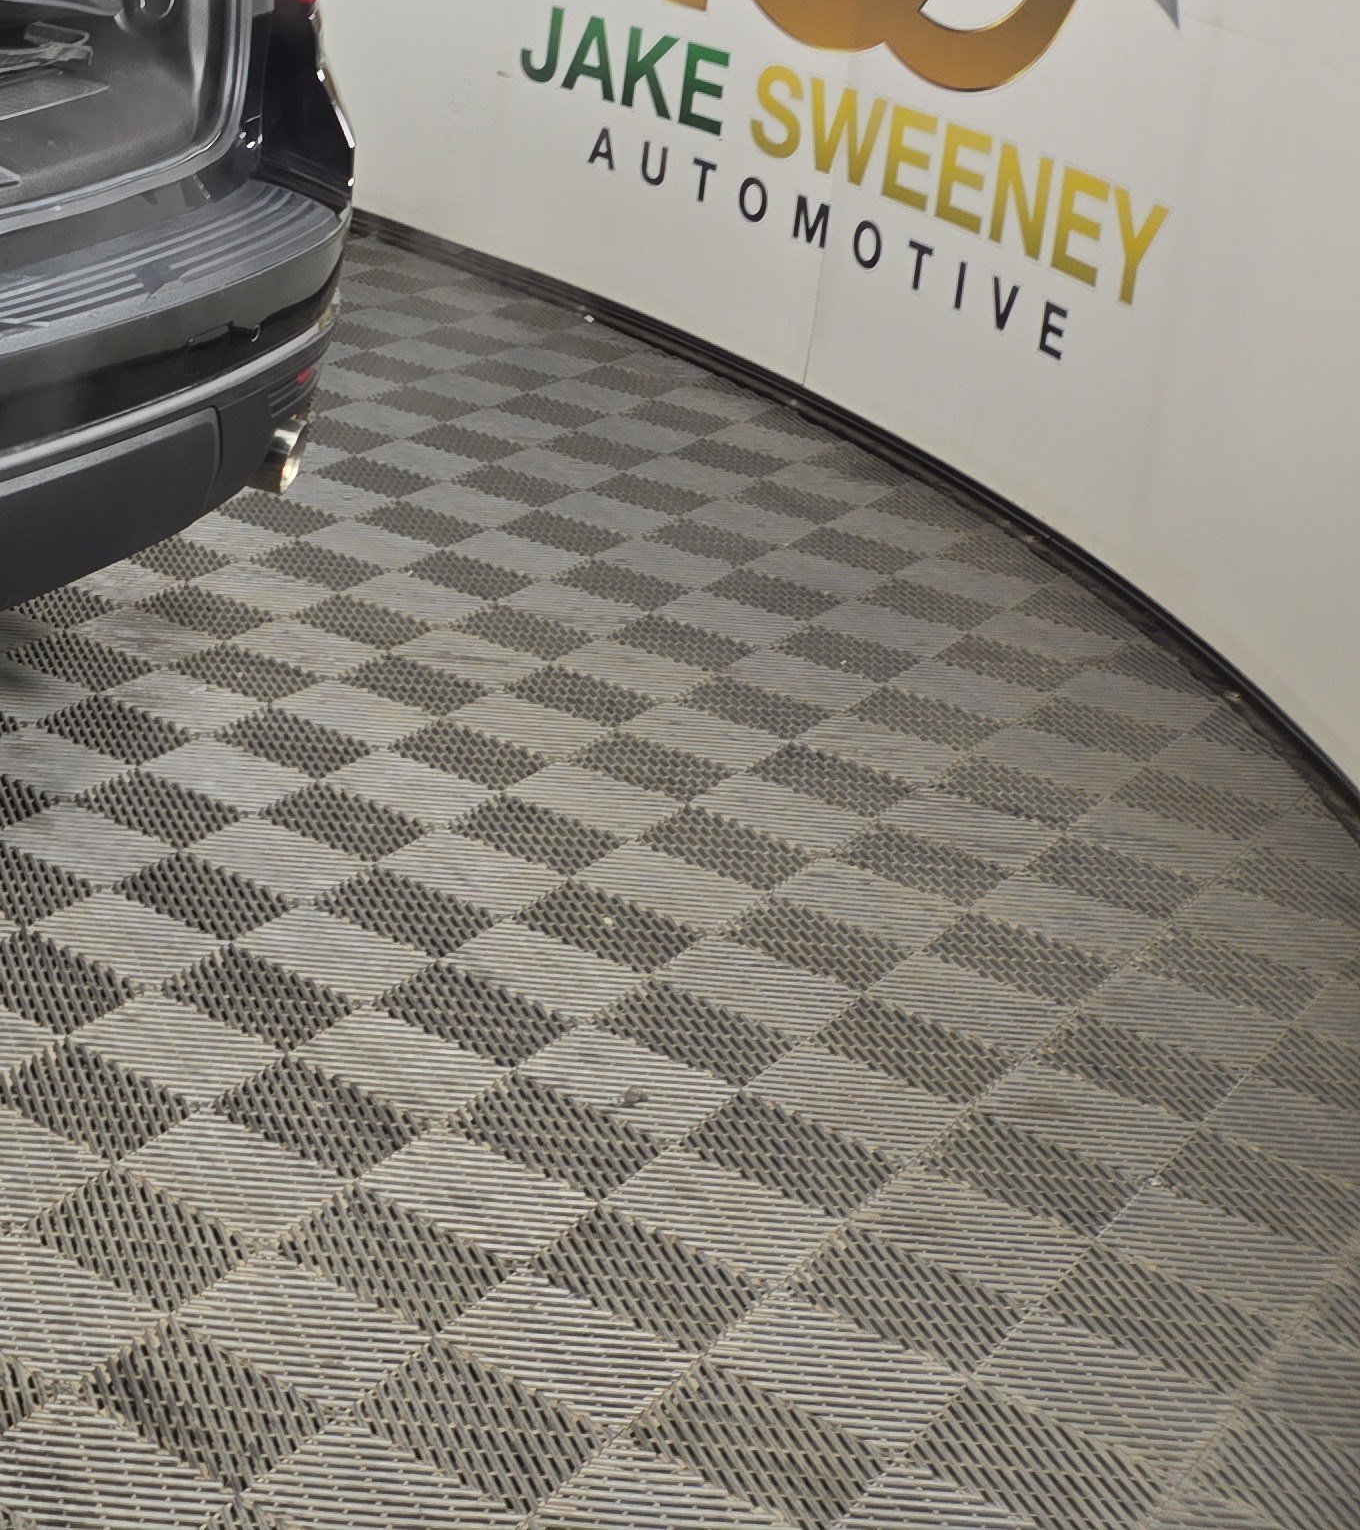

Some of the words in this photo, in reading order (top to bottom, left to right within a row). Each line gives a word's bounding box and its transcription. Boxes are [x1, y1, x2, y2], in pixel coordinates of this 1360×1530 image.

[520, 6, 731, 137] JAKE
[749, 64, 1172, 307] SWEENEY
[588, 127, 1070, 361] AUTOMOTIVE
